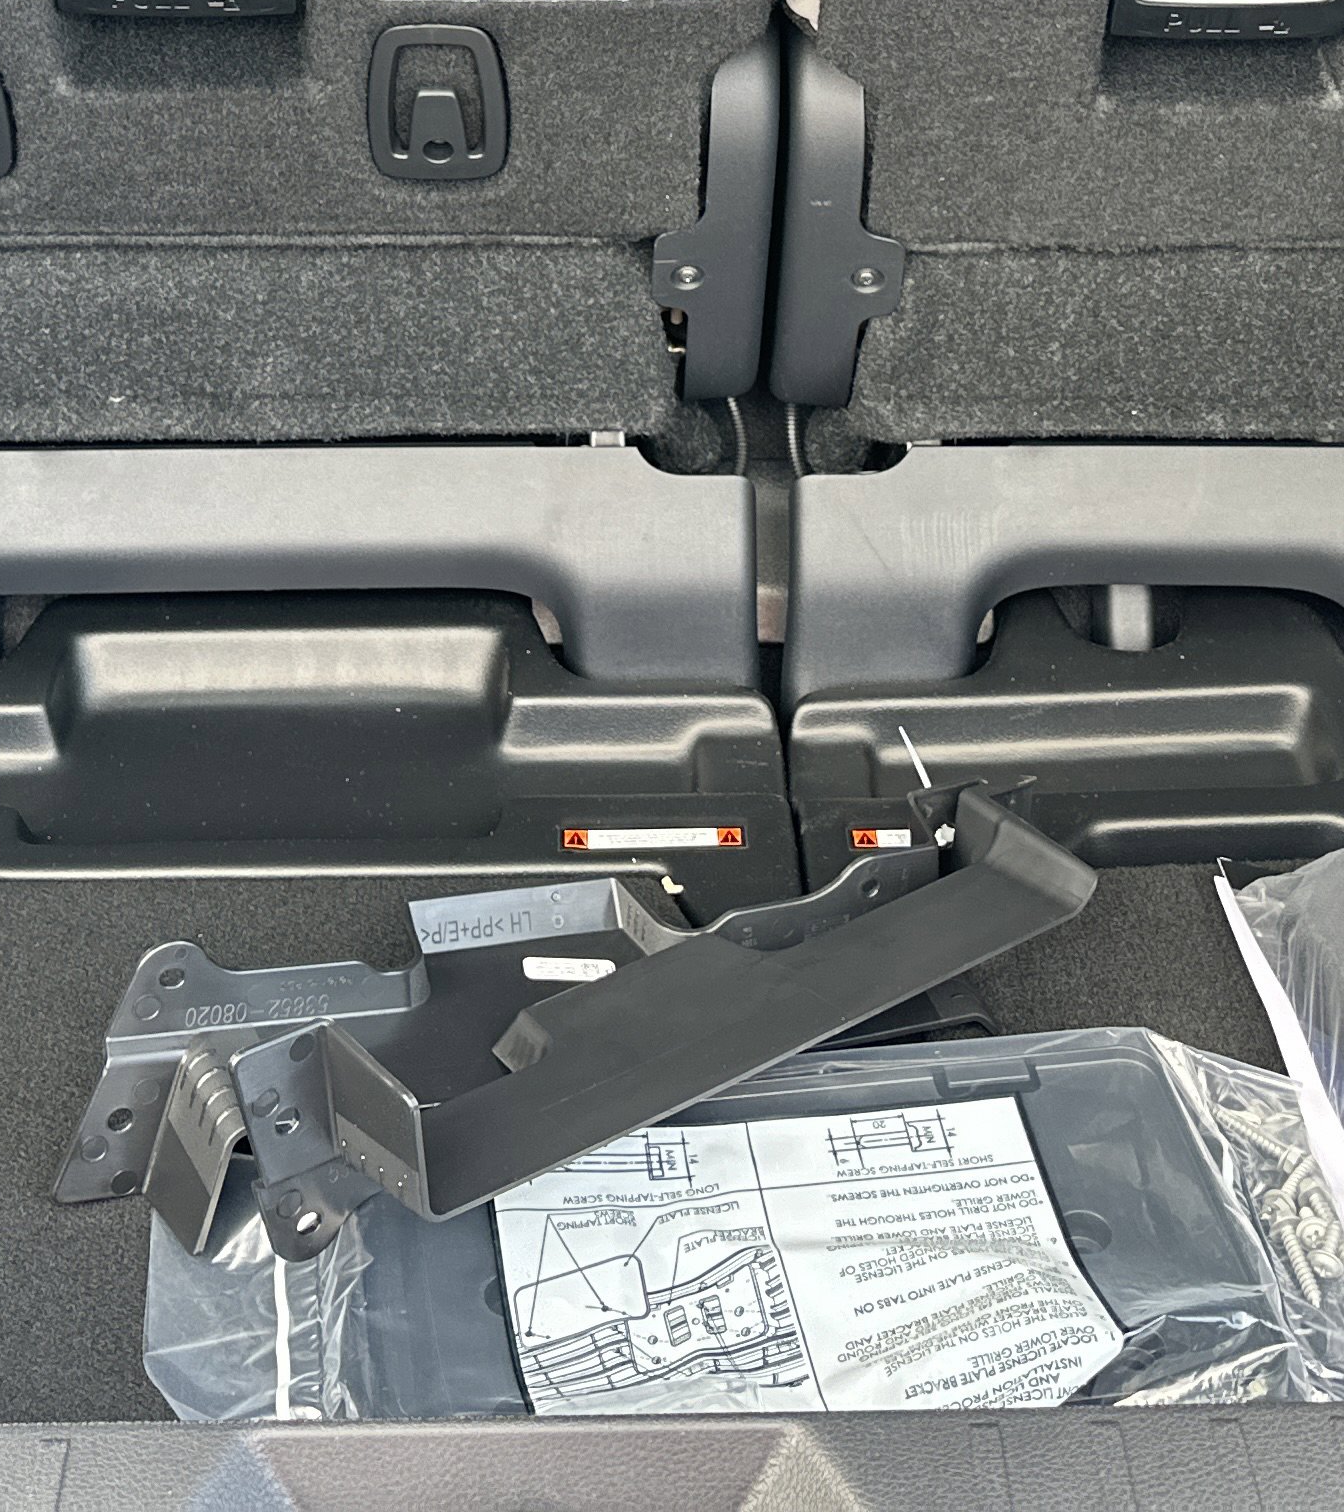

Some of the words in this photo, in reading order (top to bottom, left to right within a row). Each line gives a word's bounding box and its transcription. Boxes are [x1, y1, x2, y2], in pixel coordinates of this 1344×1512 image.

[509, 910, 533, 933] LH
[872, 1120, 886, 1129] 20
[958, 1154, 993, 1165] SHORT
[903, 1180, 980, 1197] OVERTIGHTEN
[984, 1177, 1007, 1187] NOT
[605, 1191, 682, 1203] SELF-TAPPING
[685, 1183, 720, 1197] LONG
[880, 1189, 901, 1199] THE
[997, 1190, 1035, 1202] LOWER
[562, 1194, 603, 1205] SCREW
[992, 1201, 1016, 1212] NOT
[919, 1208, 955, 1220] HOLES
[958, 1205, 989, 1215] DRILL
[835, 1217, 856, 1227] THE
[859, 1213, 917, 1225] THROUGH
[985, 1216, 1032, 1229] LICENSE
[920, 1227, 946, 1237] AND
[928, 1251, 948, 1262] ON
[839, 1265, 855, 1277] OF
[858, 1256, 896, 1272] HOLES
[904, 1257, 926, 1271] THE
[854, 1264, 903, 1283] LICENSE
[936, 1271, 971, 1290] PLATE
[907, 1284, 935, 1301] INTO
[876, 1294, 906, 1309] TABS
[853, 1302, 874, 1317] ON
[1024, 1315, 1046, 1326] THE
[876, 1316, 928, 1341] BRACKET
[982, 1318, 1021, 1338] HOLES
[1060, 1325, 1095, 1336] OVER
[845, 1335, 873, 1350] AND
[935, 1338, 956, 1352] THE
[958, 1331, 979, 1345] ON
[1015, 1330, 1057, 1354] LOWER
[1049, 1334, 1098, 1352] LOCATE
[884, 1347, 931, 1377] LICENSE
[998, 1348, 1047, 1373] LICENSE
[959, 1365, 996, 1386] PLATE
[1028, 1373, 1060, 1387] AND
[903, 1375, 956, 1400] BRACKET
